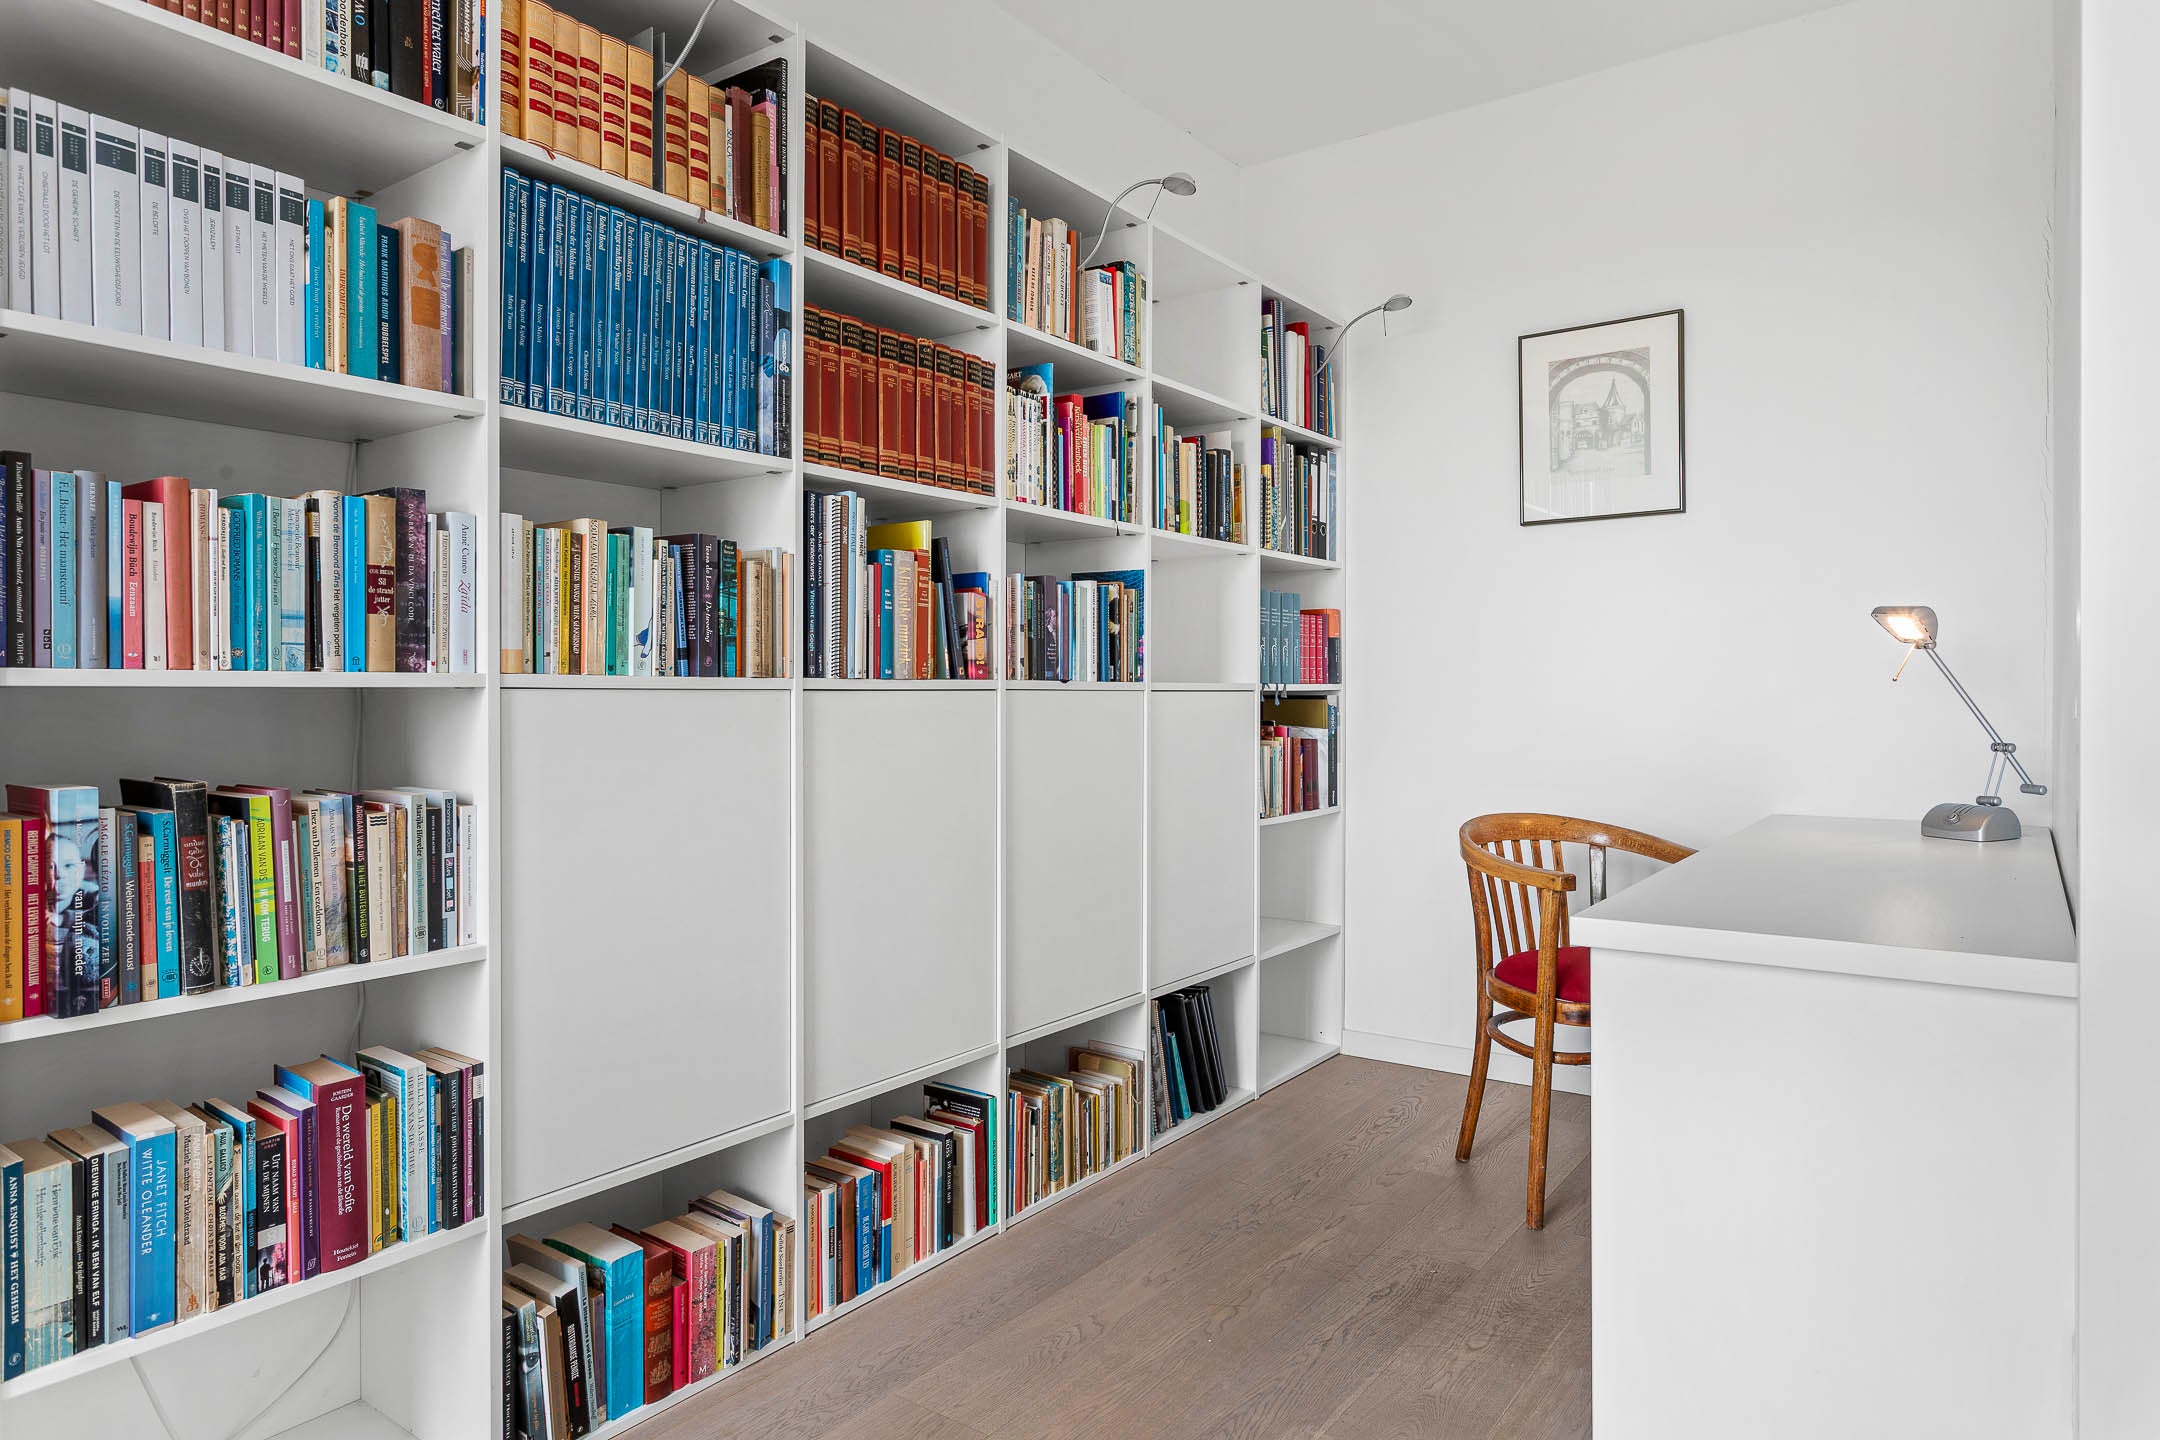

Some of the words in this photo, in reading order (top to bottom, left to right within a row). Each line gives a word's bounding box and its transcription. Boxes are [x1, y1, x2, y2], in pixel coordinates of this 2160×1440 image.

[432, 22, 443, 44] het
[432, 45, 441, 74] water
[152, 202, 158, 210] DE
[598, 233, 606, 250] Hood
[16, 461, 24, 490] Elisabeth
[16, 492, 24, 512] Barillé
[59, 531, 69, 547] Het
[127, 513, 137, 555] Boudewijn
[233, 512, 241, 548] GODFRIED
[333, 524, 340, 533] de
[59, 550, 70, 605] maansteenrif
[129, 557, 137, 577] Büch
[233, 550, 241, 581] BOMANS
[408, 565, 414, 576] DA
[706, 565, 712, 573] de
[16, 586, 24, 623] ontmaskerd
[129, 582, 137, 616] Eenzaam
[459, 580, 471, 613] Zaïda
[897, 566, 912, 621] Klassieke
[332, 603, 340, 632] vergeten
[705, 601, 712, 613] De
[333, 634, 341, 656] portret
[898, 624, 910, 664] muziek
[356, 805, 364, 834] ADRIAAN
[28, 830, 38, 853] REMCO
[256, 818, 266, 851] ADRIAAN
[101, 845, 109, 856] LE
[122, 824, 133, 878] S.Carmiggelt
[161, 820, 172, 874] S.Carmiggelt
[28, 855, 39, 885] CAMPERT
[258, 852, 266, 868] VAN
[358, 865, 364, 873] IN
[101, 858, 111, 892] CLÉZIO
[164, 876, 172, 888] De
[259, 870, 267, 881] DIS
[28, 893, 39, 905] HET
[74, 891, 83, 908] van
[164, 890, 172, 905] rest
[259, 888, 268, 897] IK
[28, 907, 39, 925] LEVEN
[102, 900, 109, 912] IN
[125, 880, 134, 942] Welverdiende
[315, 897, 323, 936] ezeldroom
[359, 890, 367, 938] BUITENGEBIED
[72, 912, 84, 934] mijn
[261, 918, 270, 942] TERUG
[165, 931, 173, 952] leven
[75, 938, 86, 976] moeder
[102, 946, 110, 964] ZEE
[126, 943, 135, 971] onrust
[341, 1105, 351, 1121] De
[343, 1123, 353, 1160] wereld
[142, 1148, 152, 1185] WITTE
[263, 1160, 270, 1170] AL
[263, 1172, 269, 1182] DE
[344, 1163, 353, 1182] van
[91, 1158, 99, 1198] DIEUWKE
[156, 1159, 167, 1196] JANET
[9, 1176, 18, 1205] ANNA
[344, 1184, 355, 1213] Sofie
[9, 1206, 18, 1249] ENQUIST
[141, 1190, 152, 1255] OLEANDER
[156, 1203, 167, 1237] FITCH
[92, 1240, 99, 1249] IK
[10, 1260, 19, 1281] HET
[10, 1283, 19, 1325] GEHEIM
[92, 1291, 100, 1307] ELF
